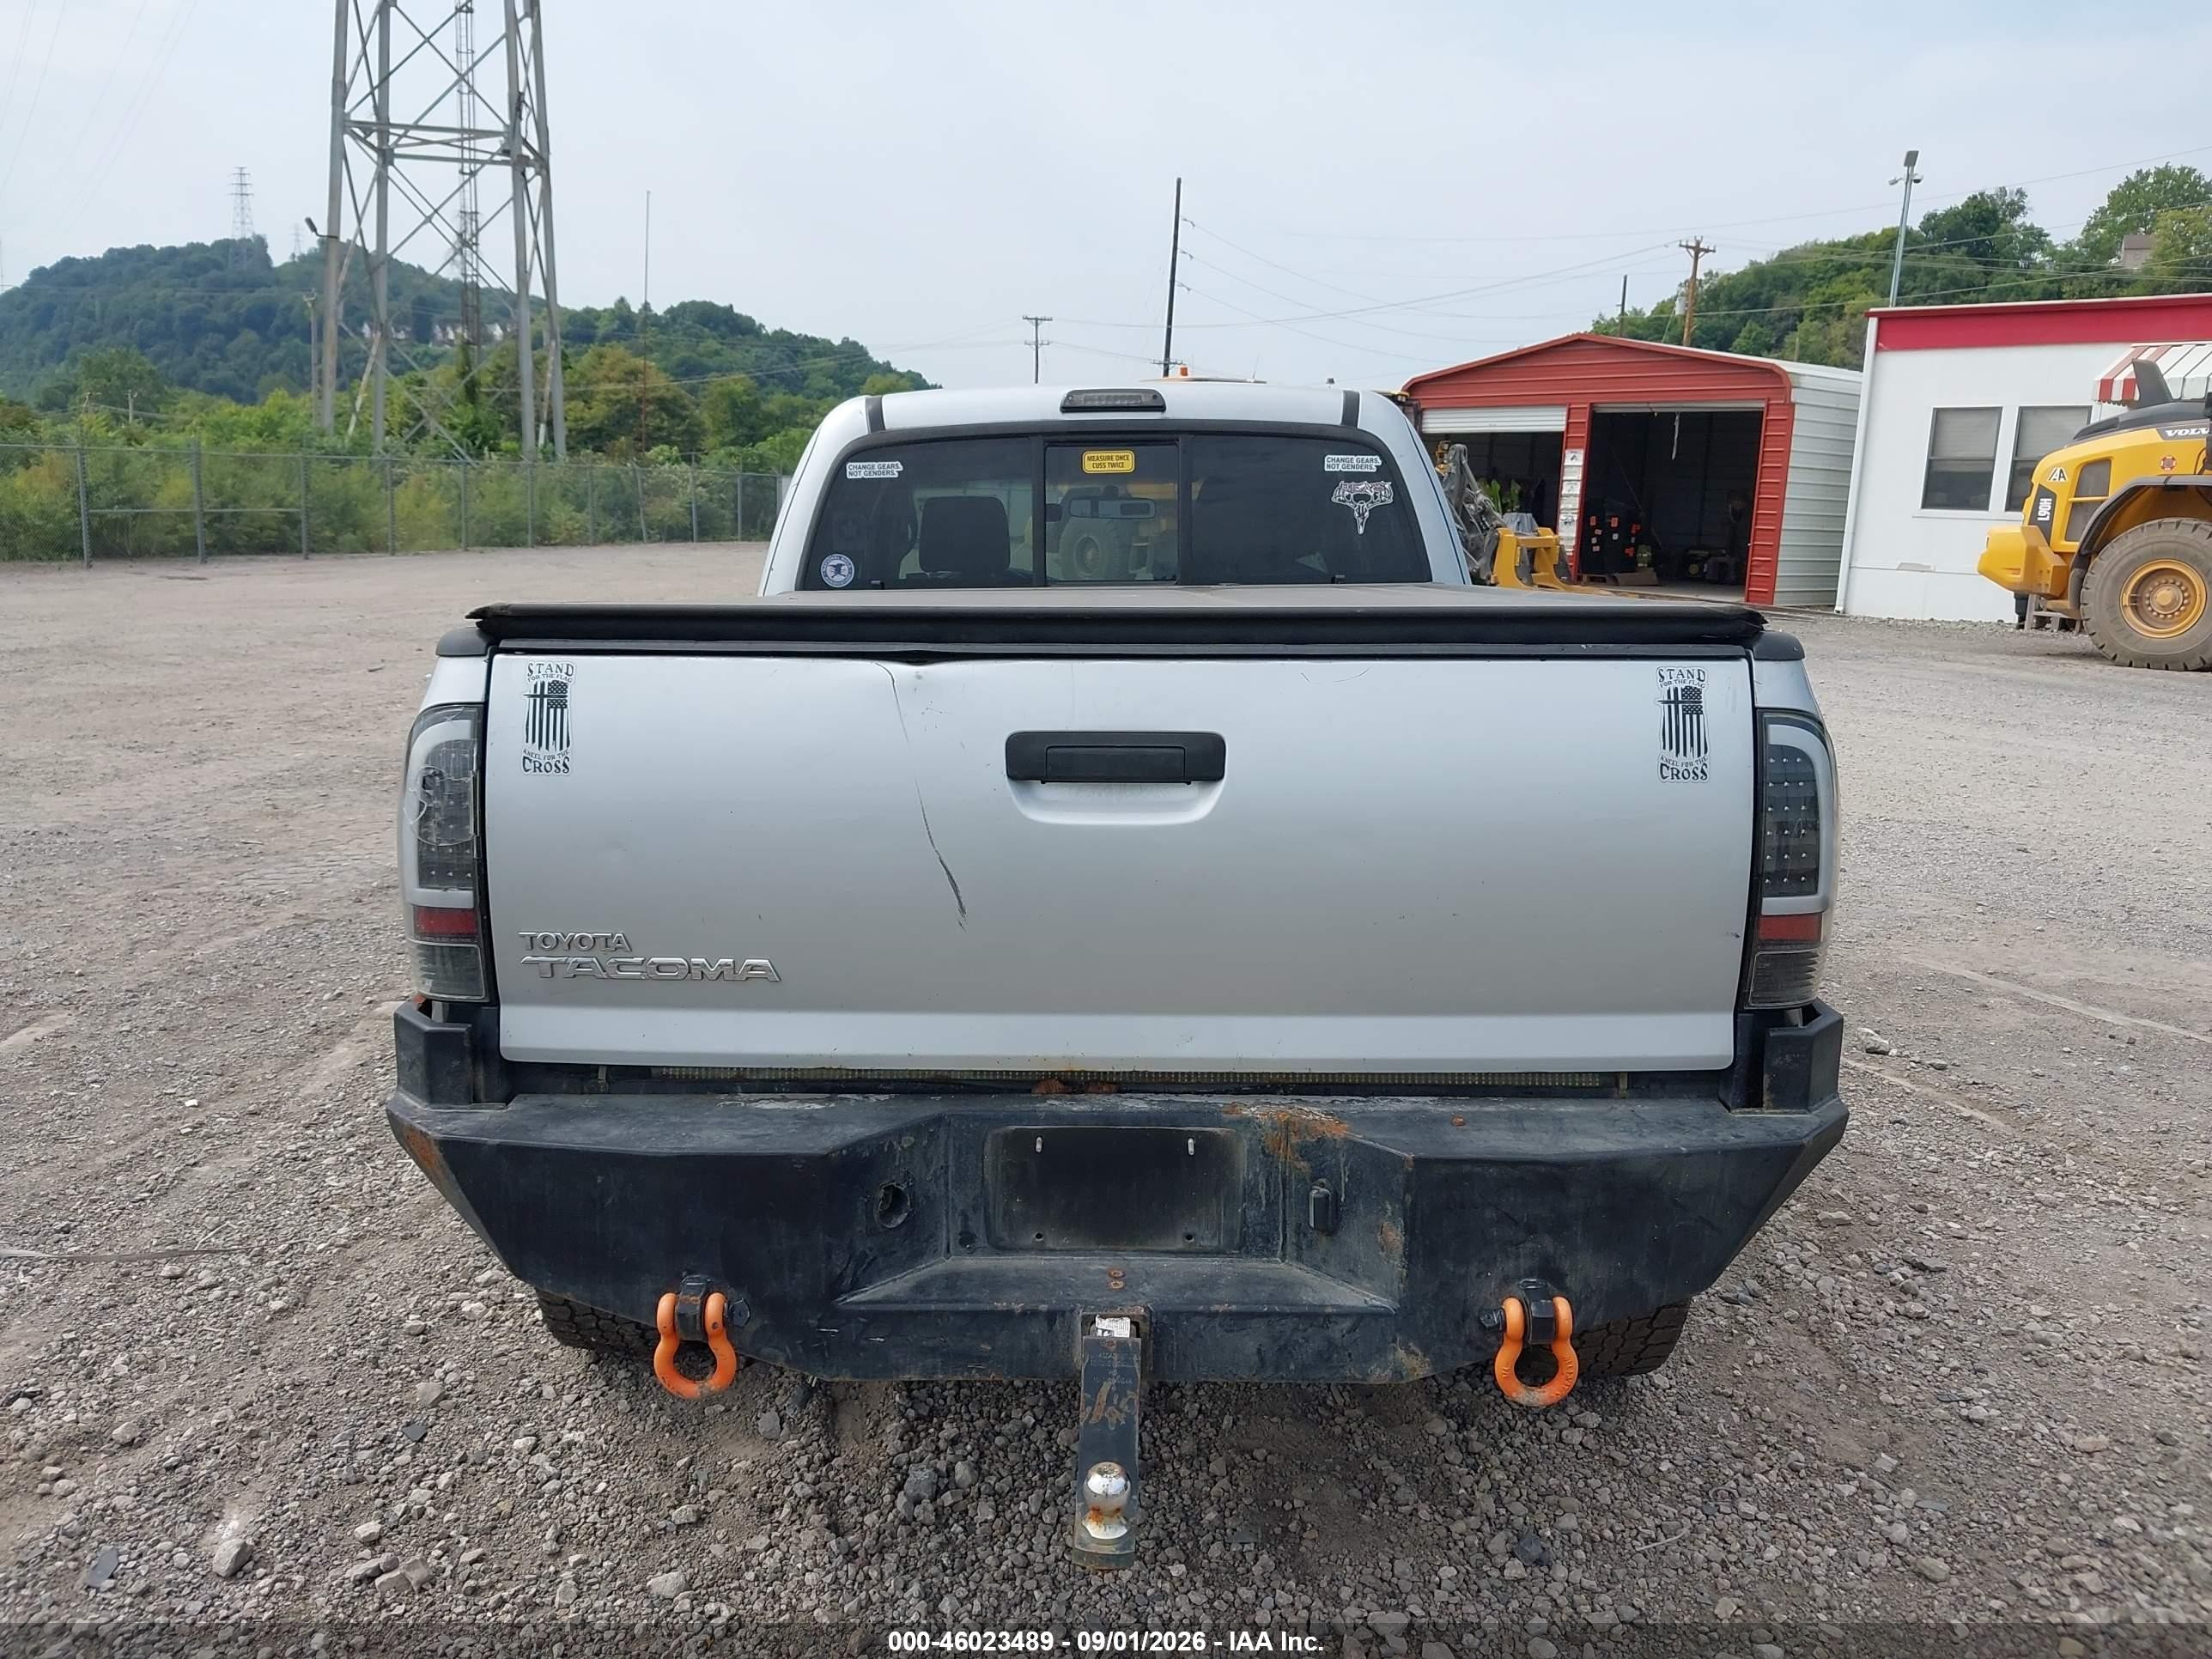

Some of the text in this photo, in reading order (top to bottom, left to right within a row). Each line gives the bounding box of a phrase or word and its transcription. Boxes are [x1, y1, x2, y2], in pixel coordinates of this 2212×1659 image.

[2165, 427, 2209, 437] VOLV
[2037, 498, 2052, 521] L90H
[527, 662, 574, 677] STAND
[1658, 668, 1706, 683] STAND
[527, 674, 540, 683] FOR
[556, 674, 574, 683] FLAG
[1689, 679, 1706, 689] FLAG
[522, 755, 570, 774] CROSS
[1661, 755, 1680, 767] KNEEL
[1695, 756, 1708, 765] THE
[1660, 763, 1708, 781] CROSS
[517, 930, 633, 952] TOYOTA
[520, 955, 782, 982] TACOMA
